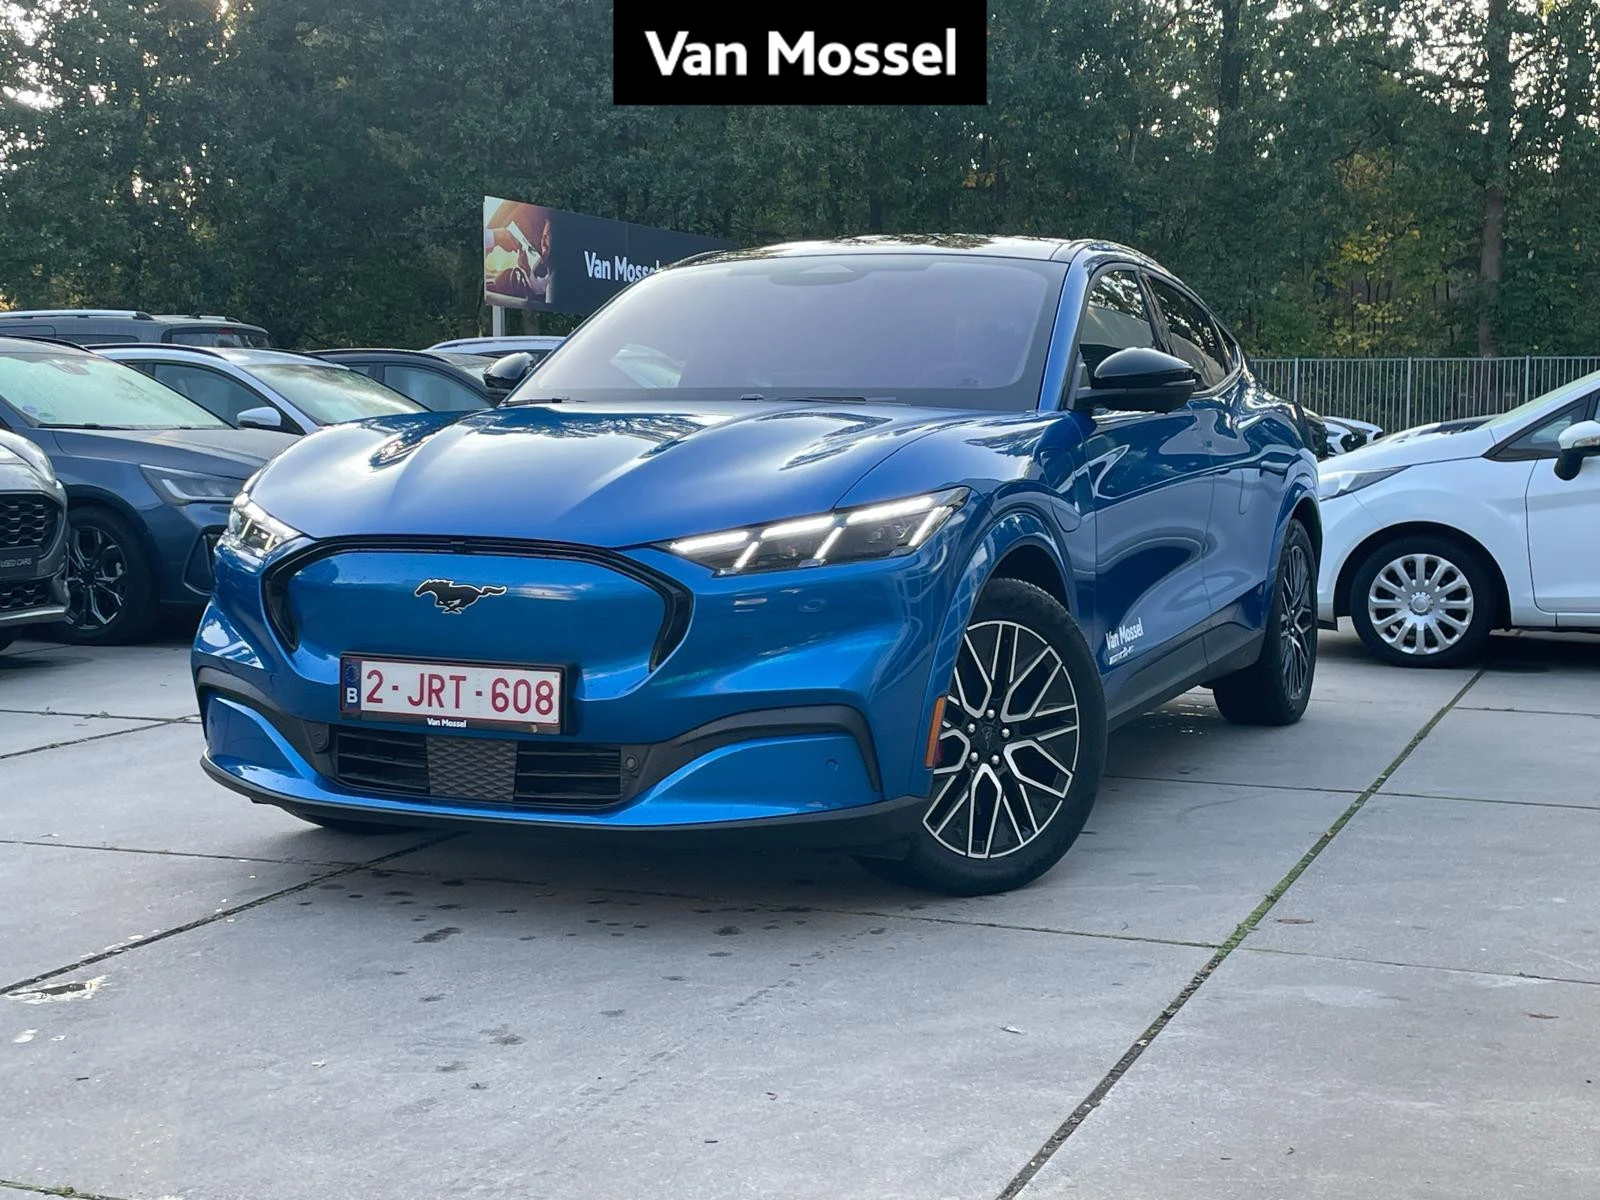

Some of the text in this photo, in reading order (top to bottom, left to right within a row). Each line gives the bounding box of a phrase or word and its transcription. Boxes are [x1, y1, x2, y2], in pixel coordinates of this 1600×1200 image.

[584, 251, 611, 280] Van
[1105, 617, 1144, 650] Van Mossel
[346, 687, 358, 703] B
[427, 718, 467, 728] Van Mossel
